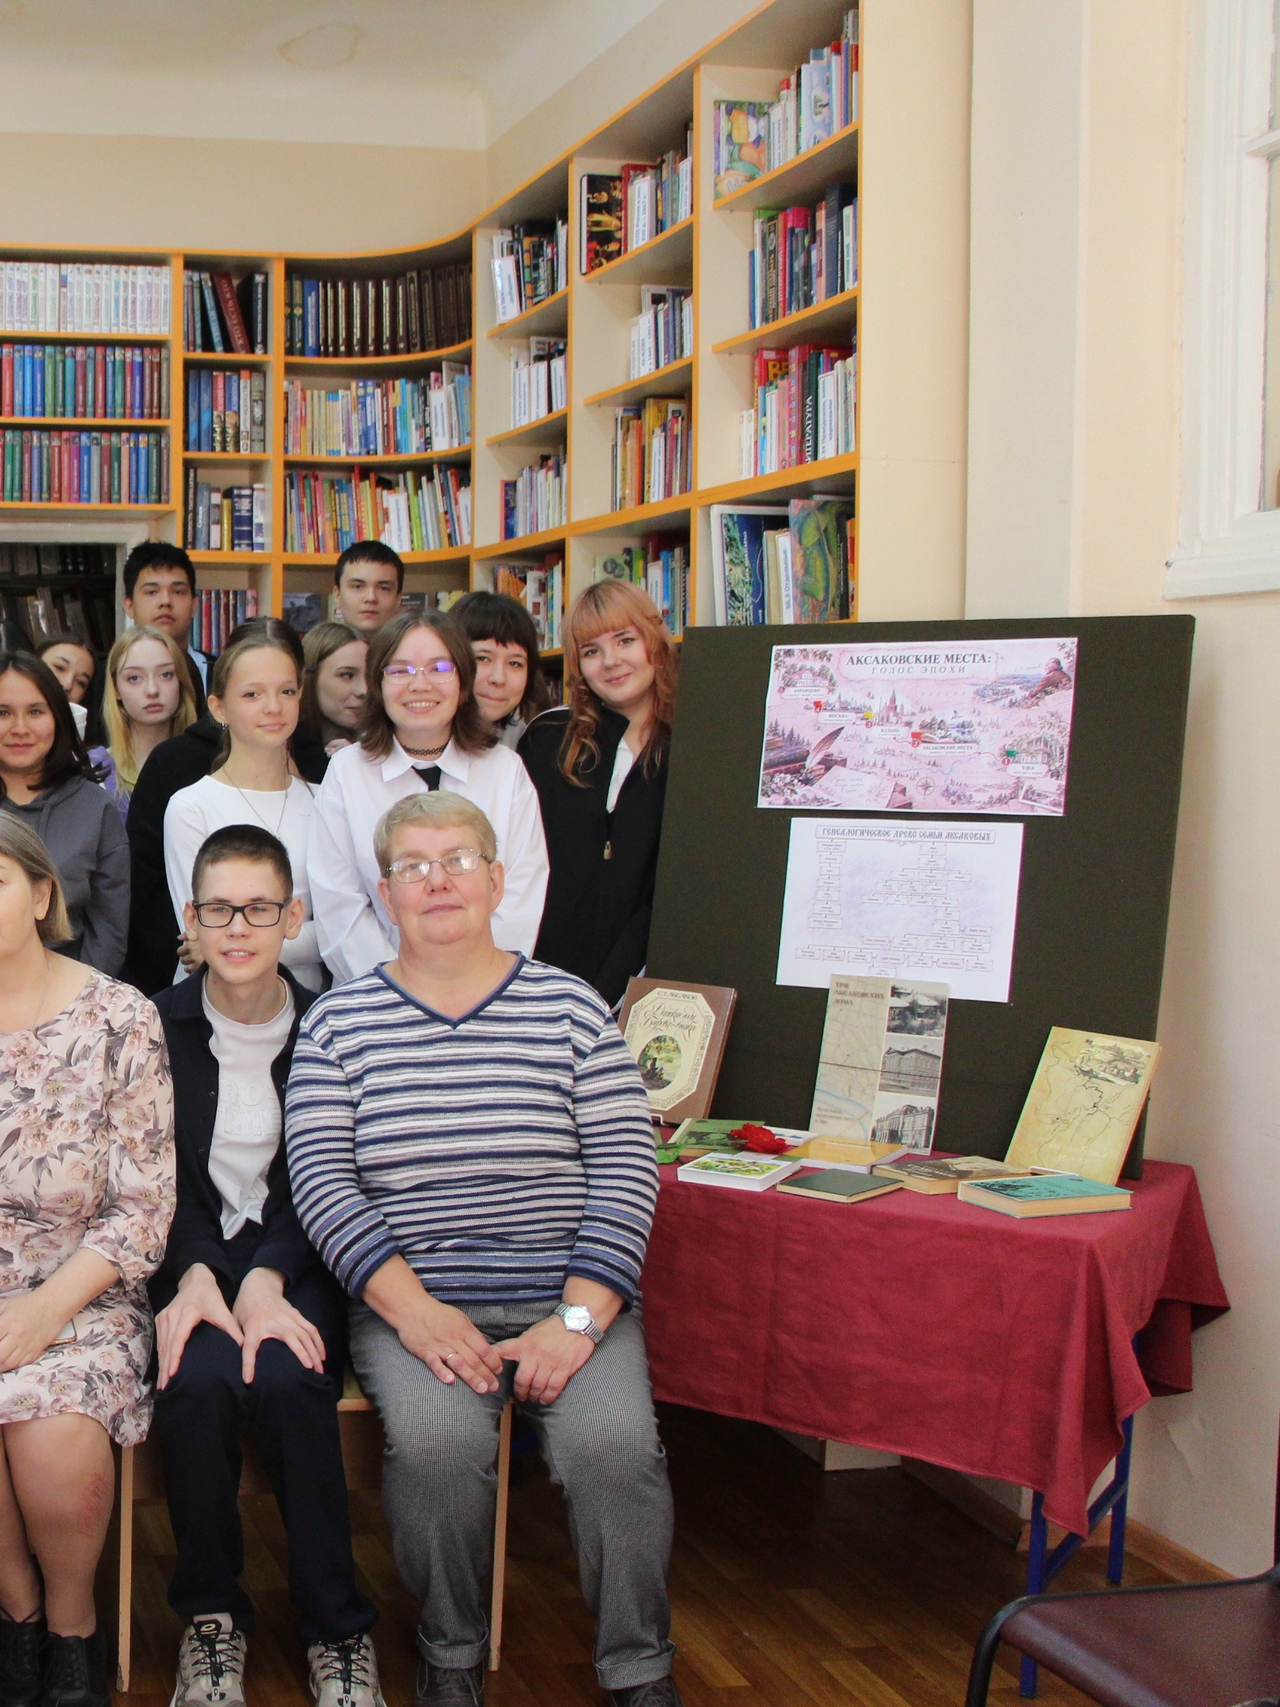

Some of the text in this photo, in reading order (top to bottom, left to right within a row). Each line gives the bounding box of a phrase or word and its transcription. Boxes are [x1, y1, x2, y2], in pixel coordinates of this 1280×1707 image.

[846, 653, 992, 666] АКСАКОВСКИЕ МЕСТА:
[871, 666, 966, 675] ГОЛОС ЭПОХИ
[822, 827, 991, 841] ГЕНЕАЛОГИЧЕСКОЕ ДРЕВО СЕМЬИ АКСАКОВЫХ
[835, 981, 849, 989] ТРИ
[833, 989, 885, 999] АКСАКОВСКИХ
[833, 998, 853, 1006] ДОМА
